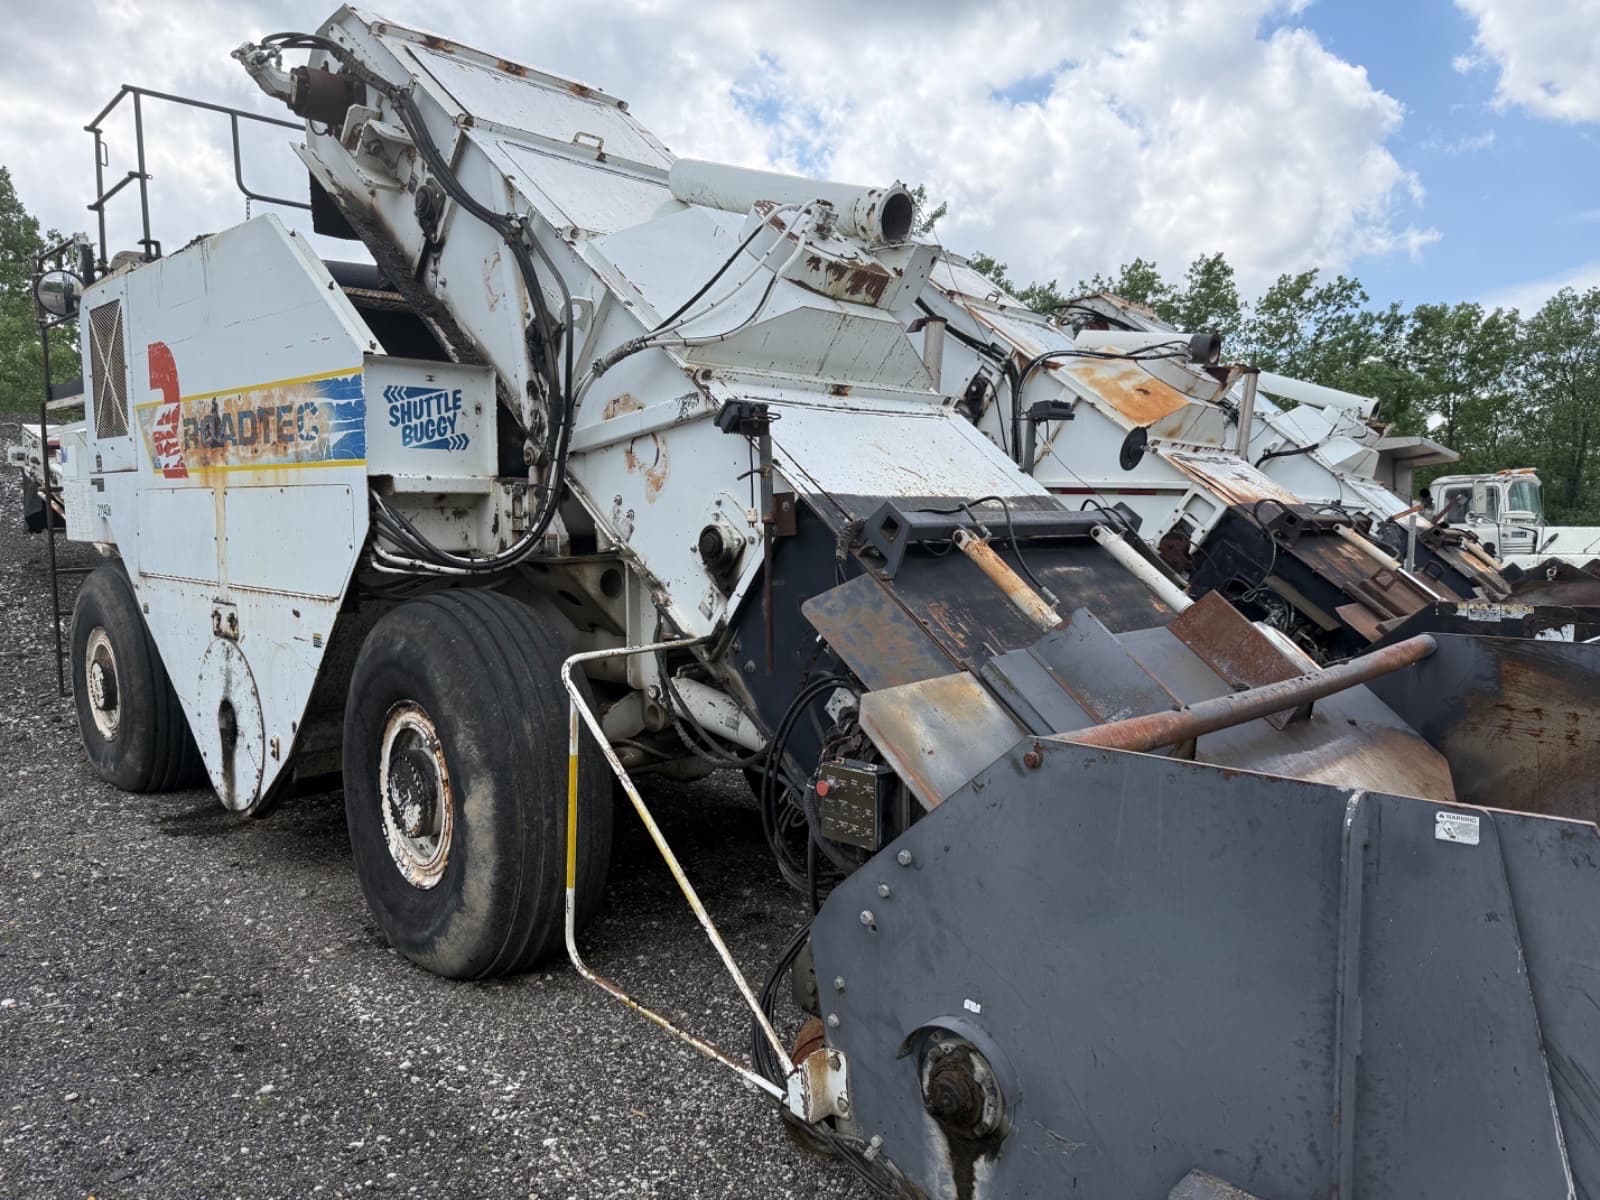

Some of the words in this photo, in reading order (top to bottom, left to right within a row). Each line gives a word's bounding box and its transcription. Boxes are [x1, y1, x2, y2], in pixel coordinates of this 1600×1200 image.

[183, 401, 319, 449] ROADTEC
[389, 389, 462, 427] SHUTTLE
[401, 411, 457, 447] BUGGY
